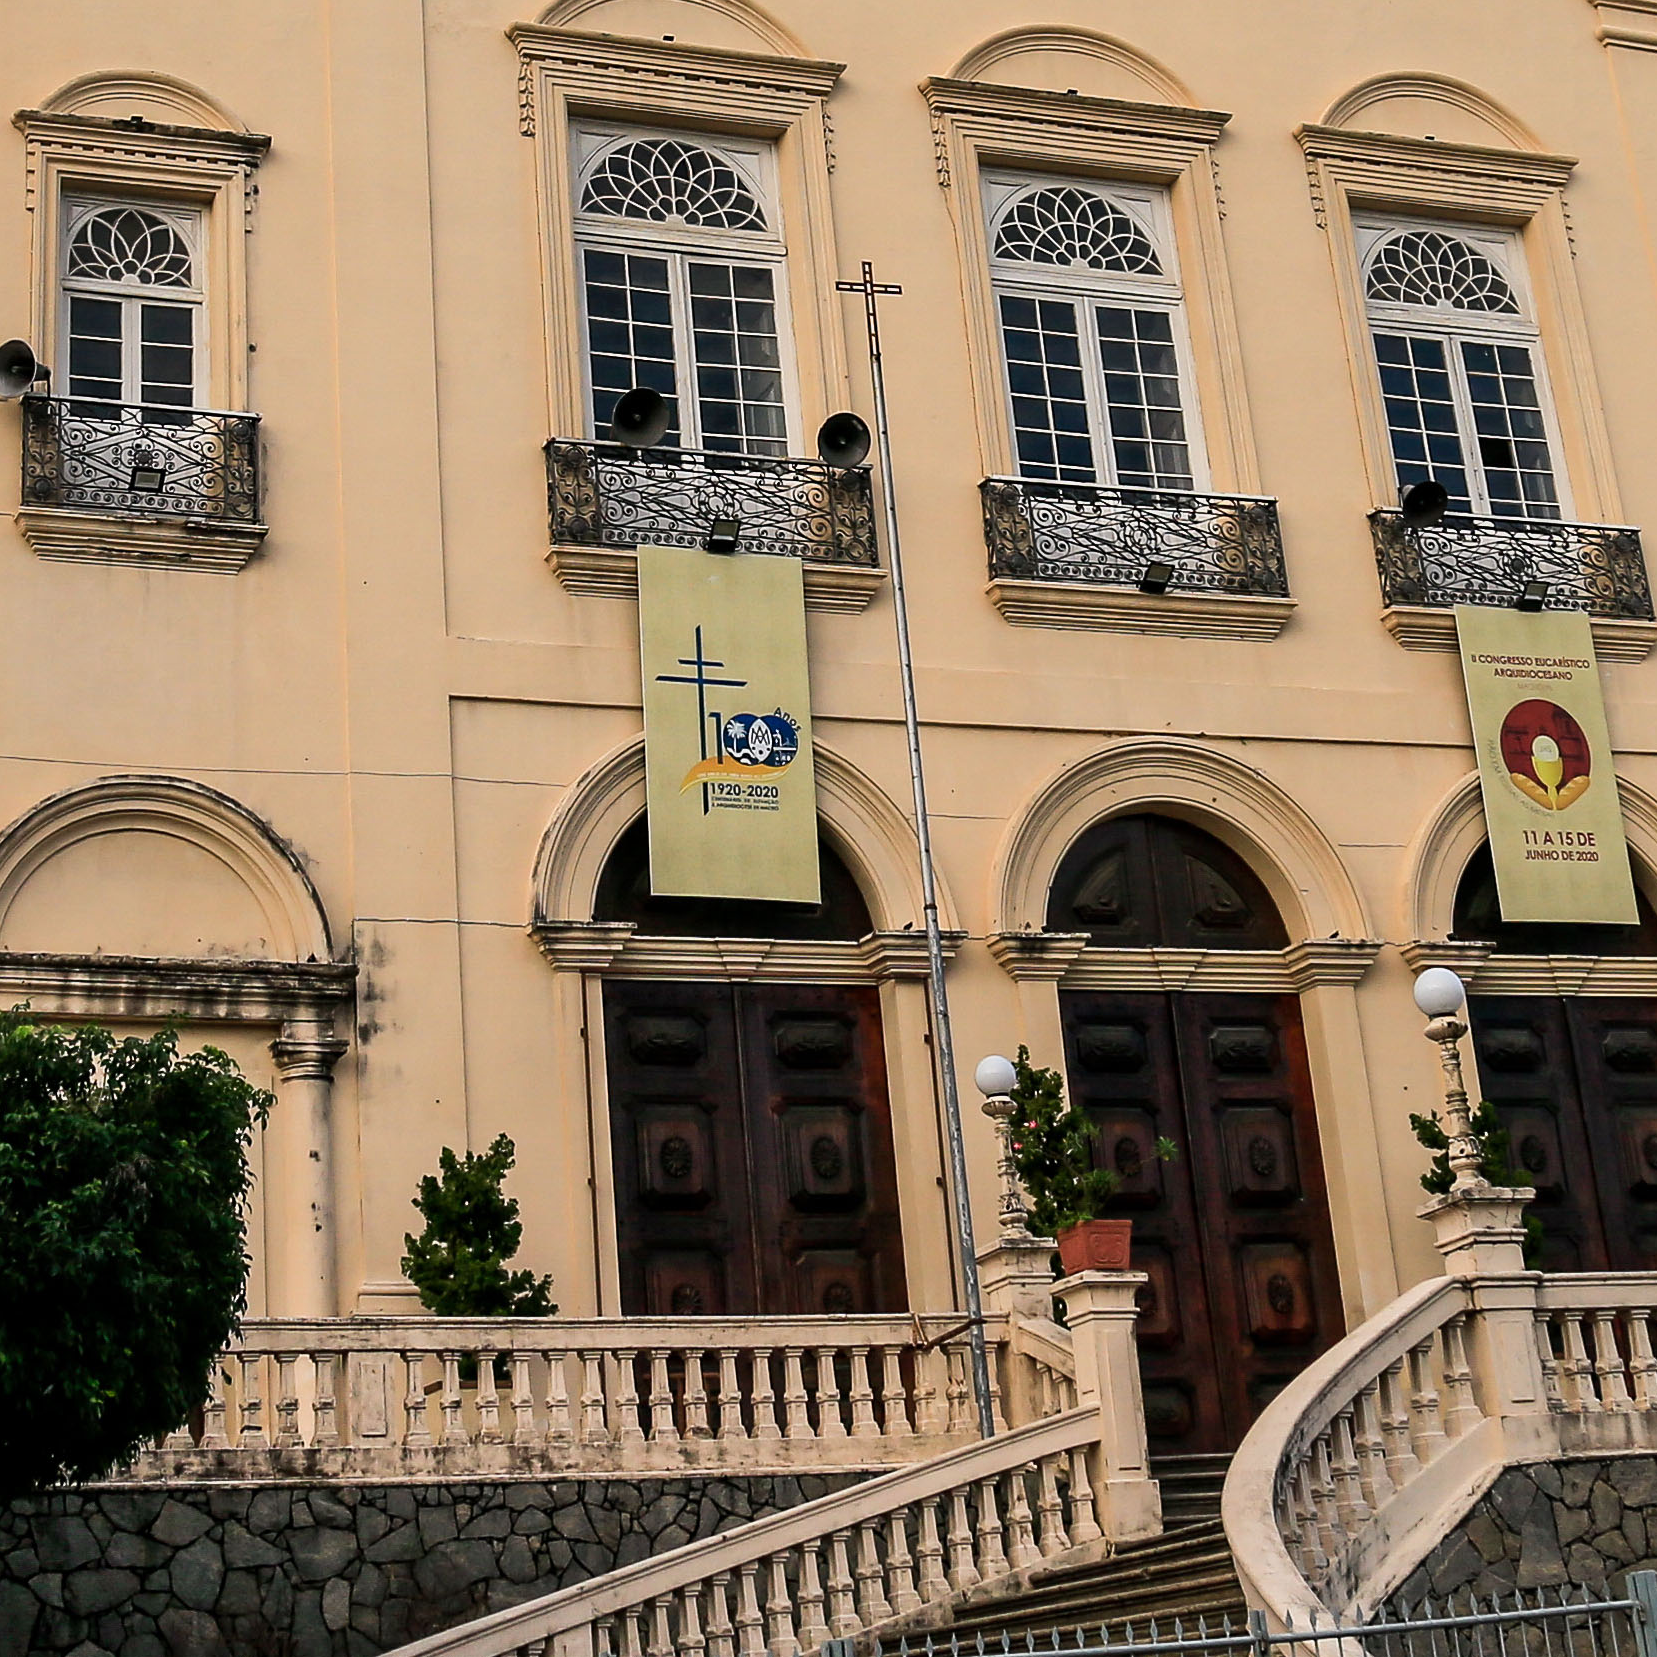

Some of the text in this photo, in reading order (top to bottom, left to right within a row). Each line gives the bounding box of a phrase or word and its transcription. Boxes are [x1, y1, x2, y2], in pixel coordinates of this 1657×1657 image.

[1478, 654, 1533, 666] CONGRESSO
[1534, 656, 1590, 669] EUCARÍSTICO
[1494, 668, 1573, 681] ARQUIDIOCESANO
[773, 706, 802, 733] Anos
[710, 782, 779, 798] 1920-2020
[1523, 830, 1596, 847] 11 A 15 DE
[1525, 850, 1599, 862] JUNHO DE 2020
